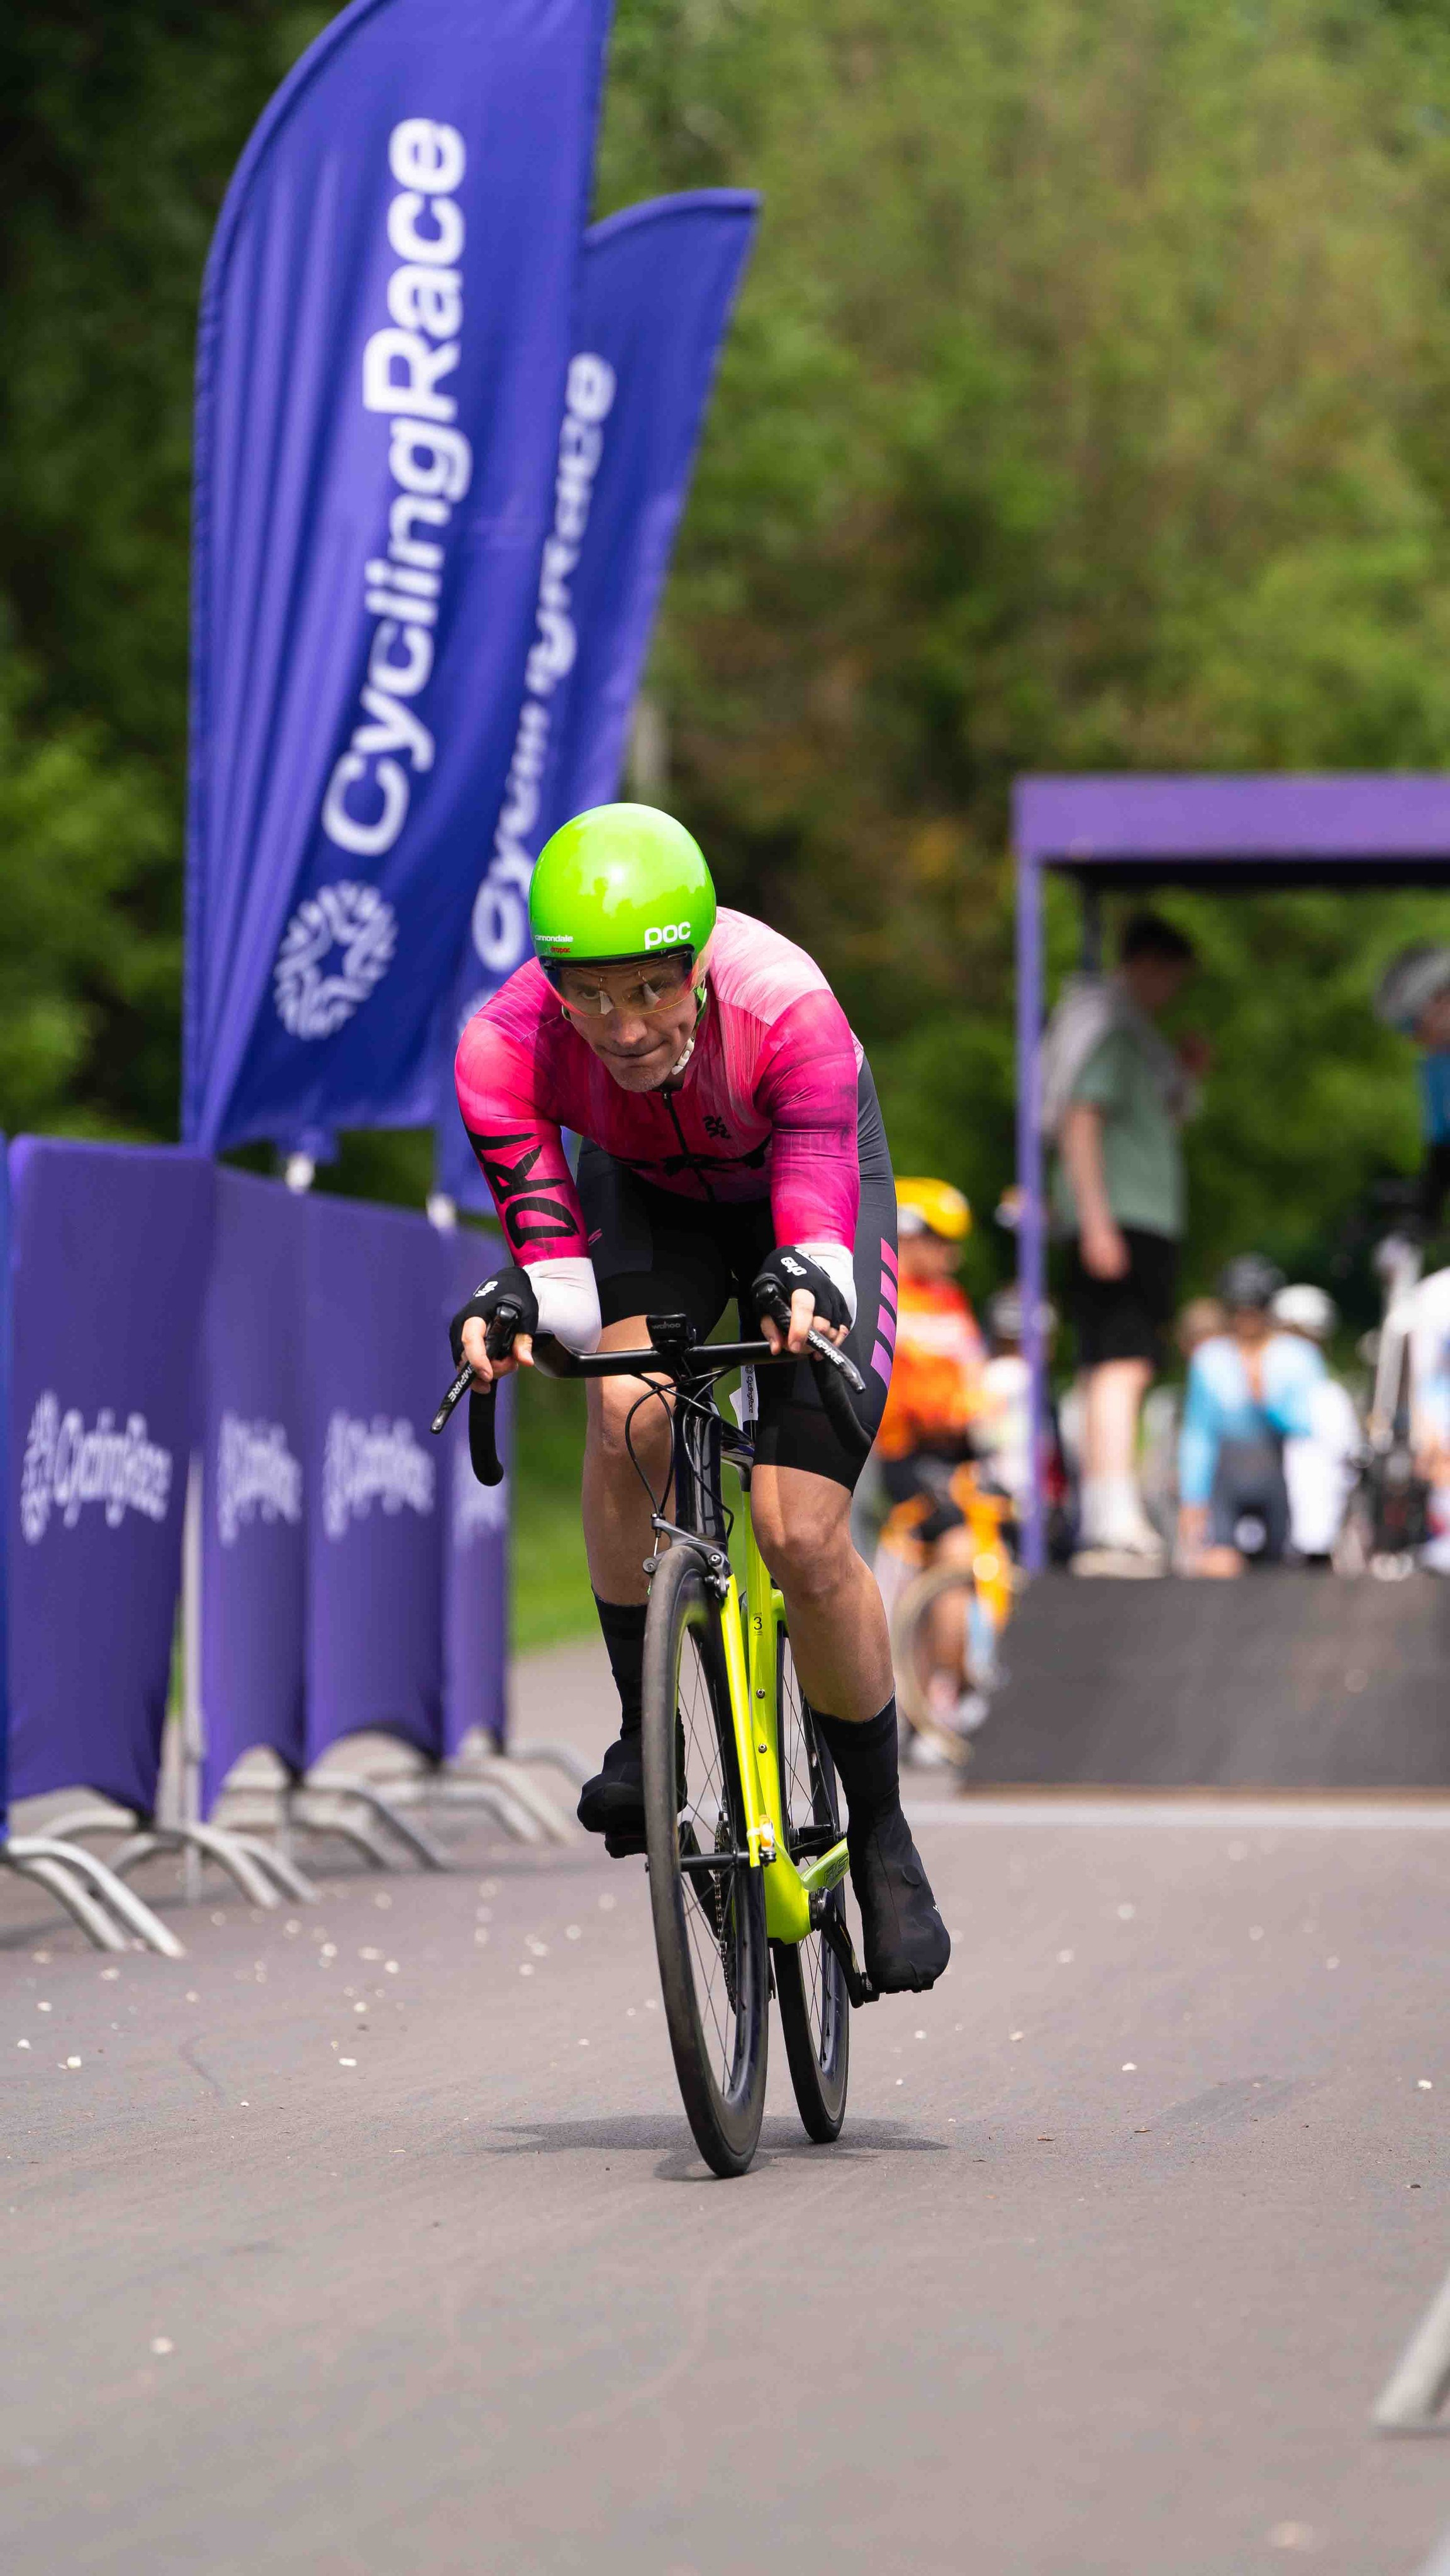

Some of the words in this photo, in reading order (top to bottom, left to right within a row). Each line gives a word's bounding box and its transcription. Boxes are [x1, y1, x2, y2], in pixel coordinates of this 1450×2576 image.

[321, 117, 473, 857] CyclingRace
[645, 921, 691, 950] poc
[447, 1365, 474, 1403] MPIRE
[754, 1616, 762, 1630] 3
